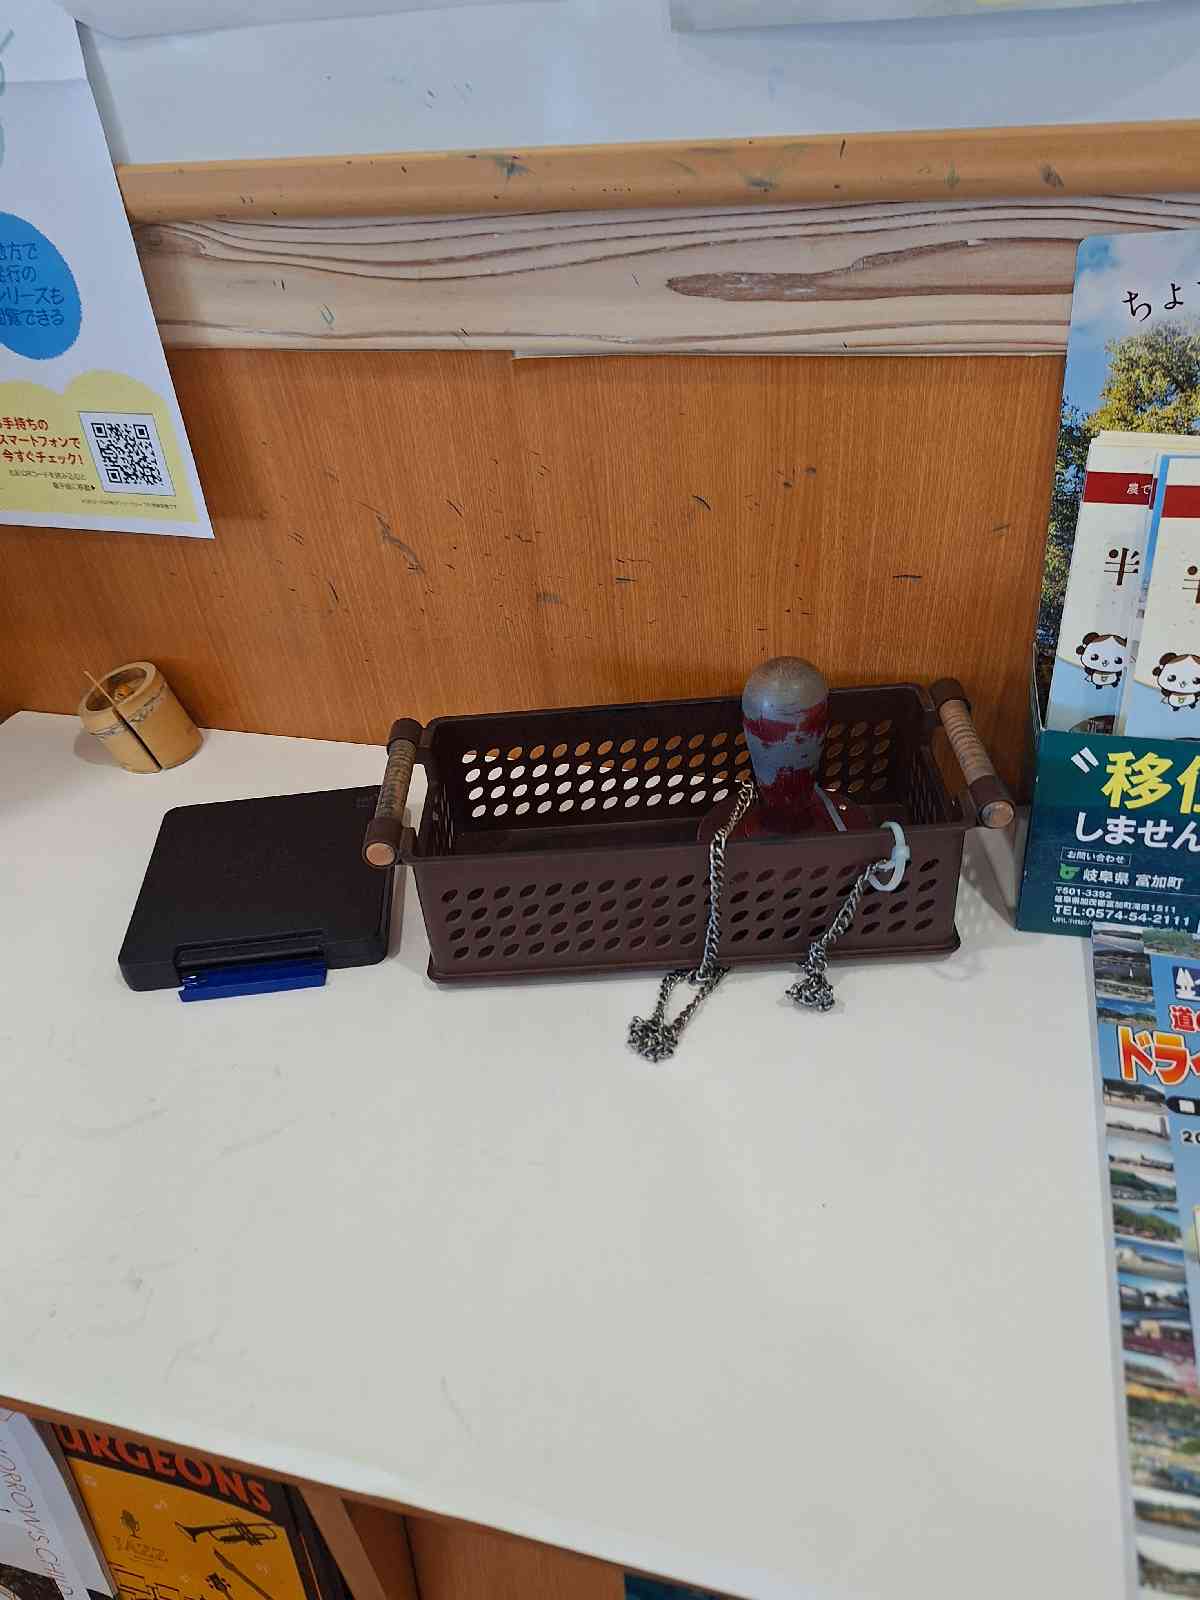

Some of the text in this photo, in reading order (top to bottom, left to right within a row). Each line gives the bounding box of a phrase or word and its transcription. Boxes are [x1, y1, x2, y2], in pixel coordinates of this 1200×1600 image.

[1122, 279, 1200, 322] ちょ
[0, 416, 49, 431] 手持ちの
[1066, 850, 1125, 865] お問い合わせ
[1082, 867, 1184, 891] 岐阜県 富加町
[1169, 1004, 1200, 1034] 道
[1117, 1024, 1200, 1087] ドラ
